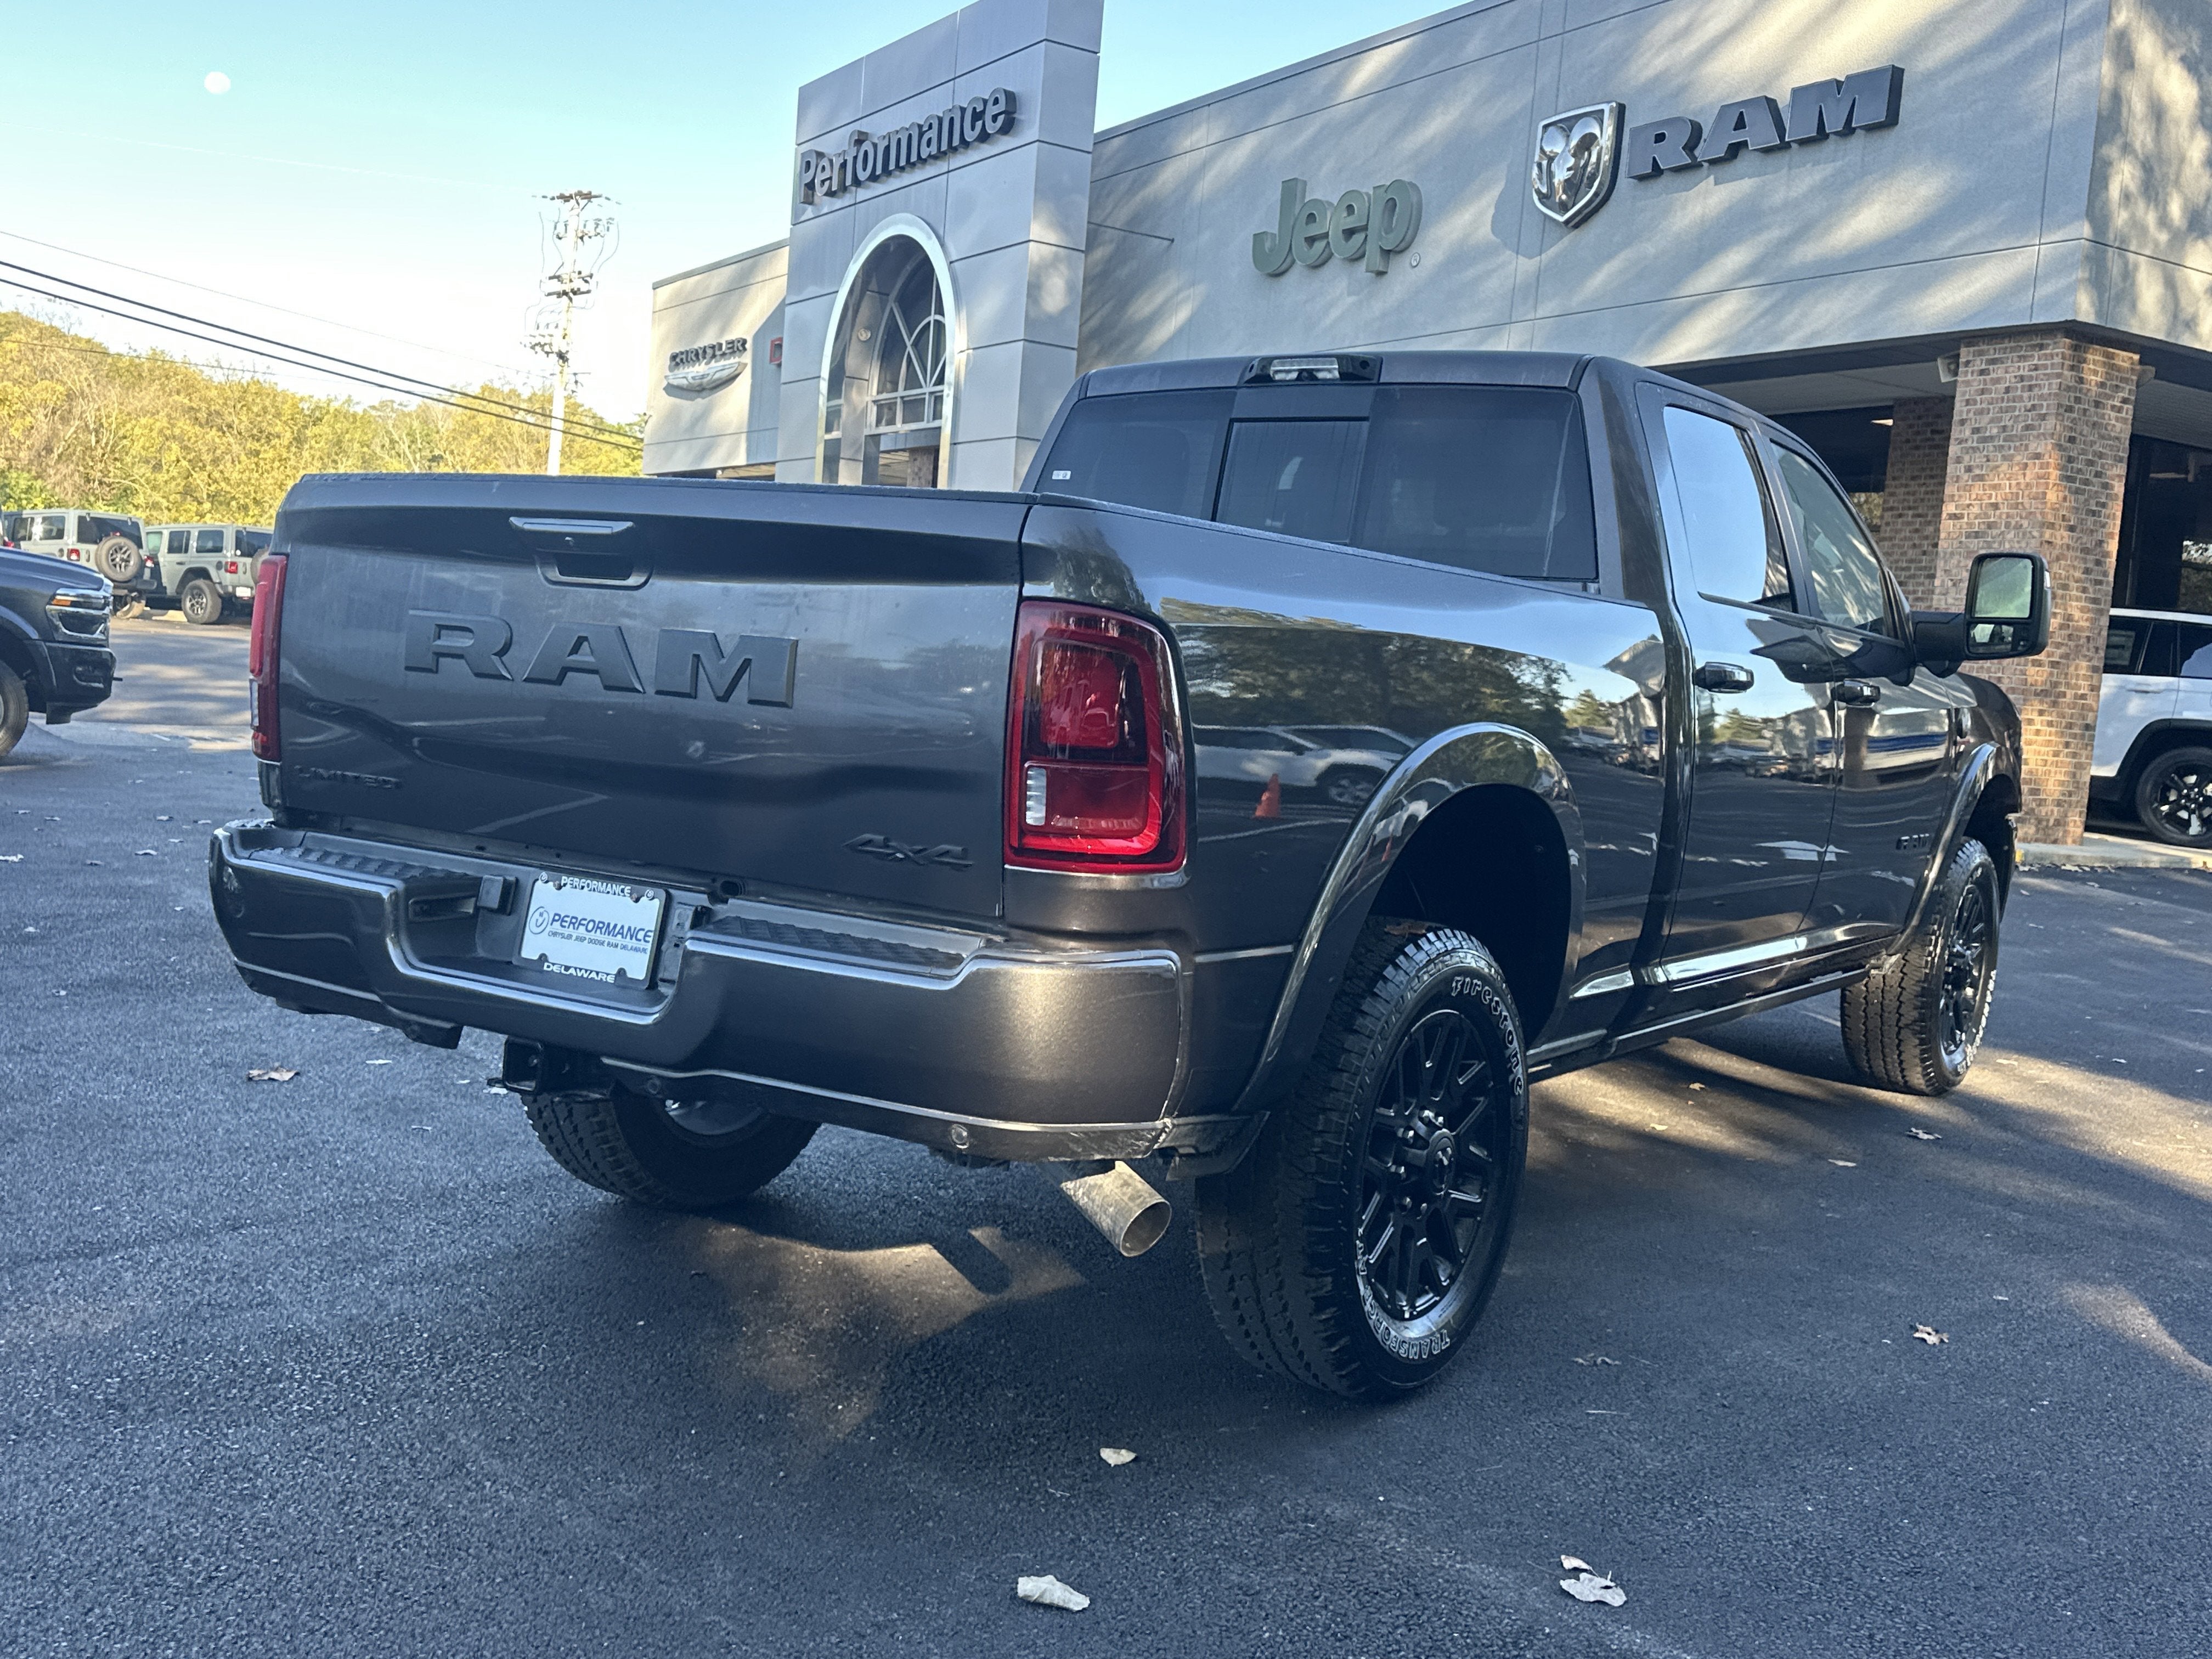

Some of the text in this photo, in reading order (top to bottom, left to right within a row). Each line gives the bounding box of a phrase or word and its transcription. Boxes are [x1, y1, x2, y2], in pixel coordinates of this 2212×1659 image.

[1625, 64, 1905, 181] RAM
[799, 87, 1017, 205] Performance
[1252, 177, 1423, 276] Jeep
[669, 337, 747, 366] CHRYSLER
[404, 609, 799, 708] RAM
[561, 876, 631, 898] PERFORMANCE
[548, 930, 648, 955] CHRYSLER JEEP DODGE RAM DELAWARE
[550, 912, 653, 944] PERFORMANCE
[543, 962, 616, 984] DELAWARE
